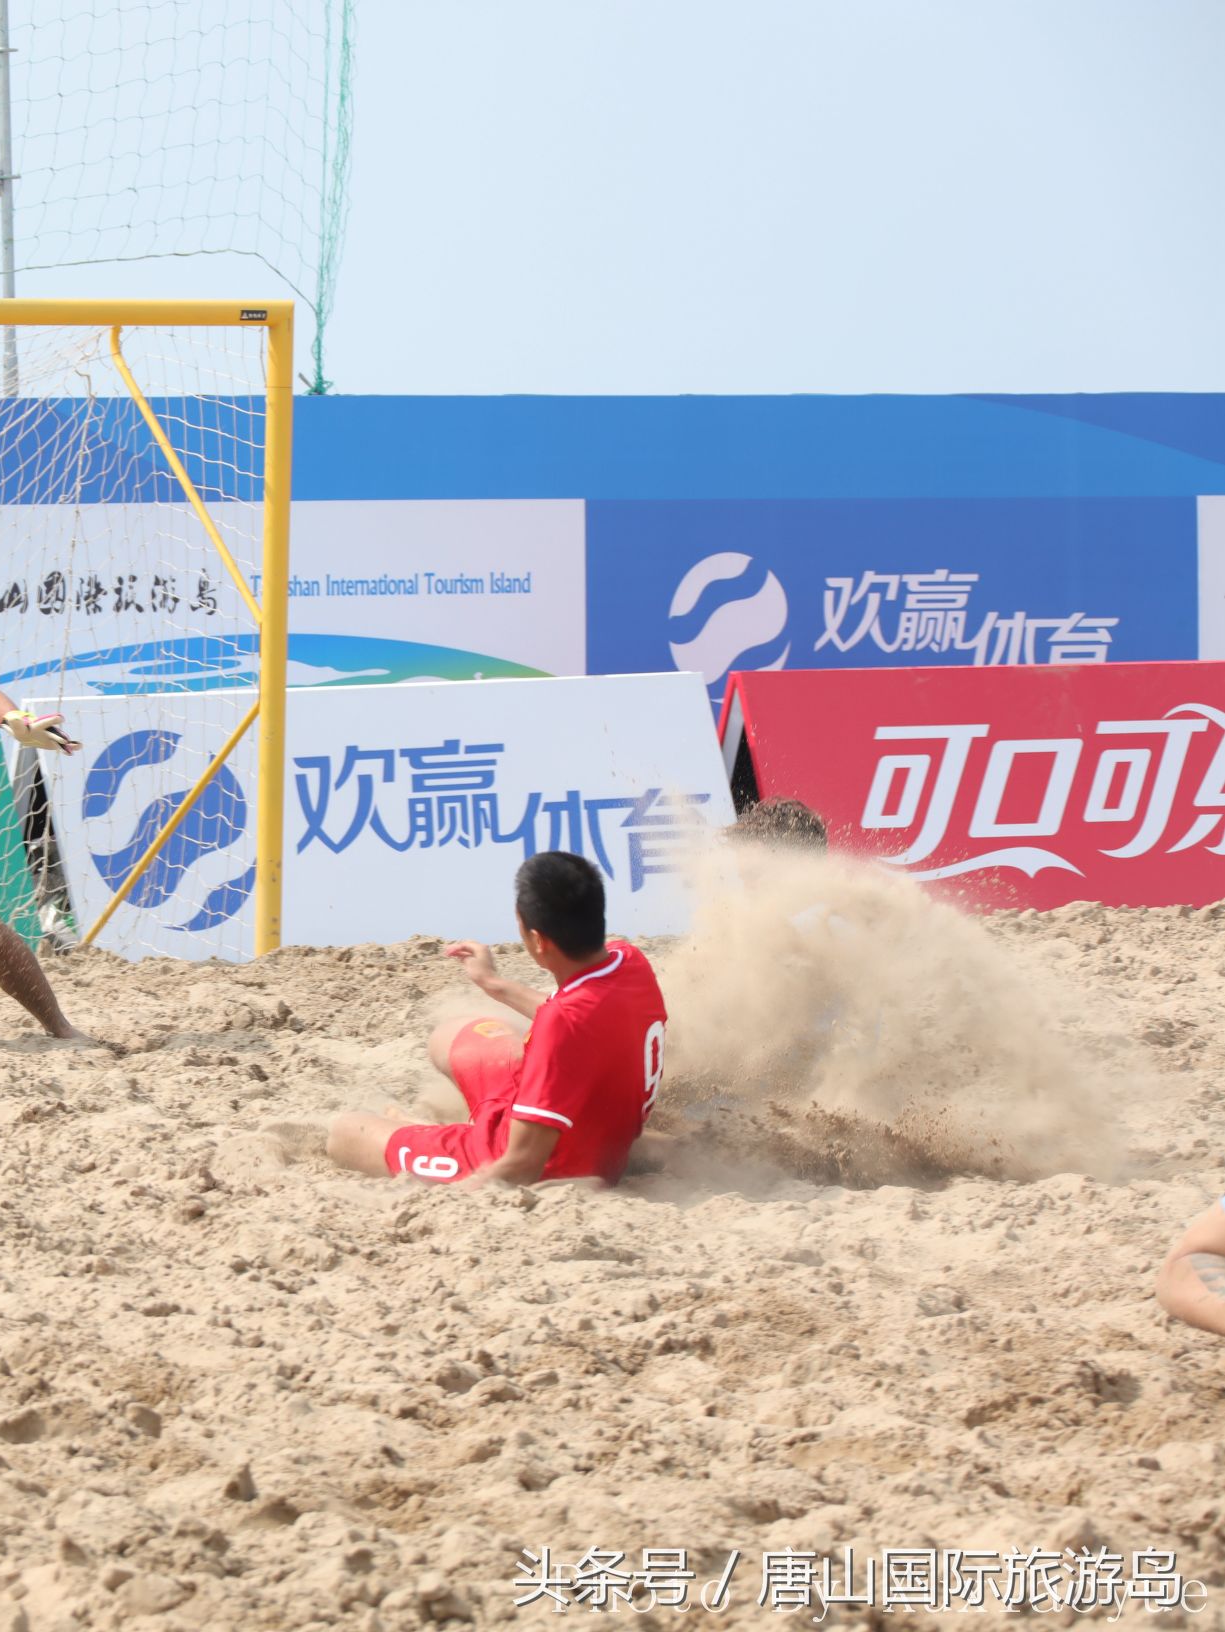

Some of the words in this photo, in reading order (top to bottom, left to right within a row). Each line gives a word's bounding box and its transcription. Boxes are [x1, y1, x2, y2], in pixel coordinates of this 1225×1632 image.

[250, 574, 320, 598] Tshan
[326, 574, 418, 596] International
[424, 572, 484, 595] Tourism
[490, 571, 531, 594] Island
[814, 569, 1120, 666] 欢赢体育
[292, 739, 711, 893] 欢赢体育
